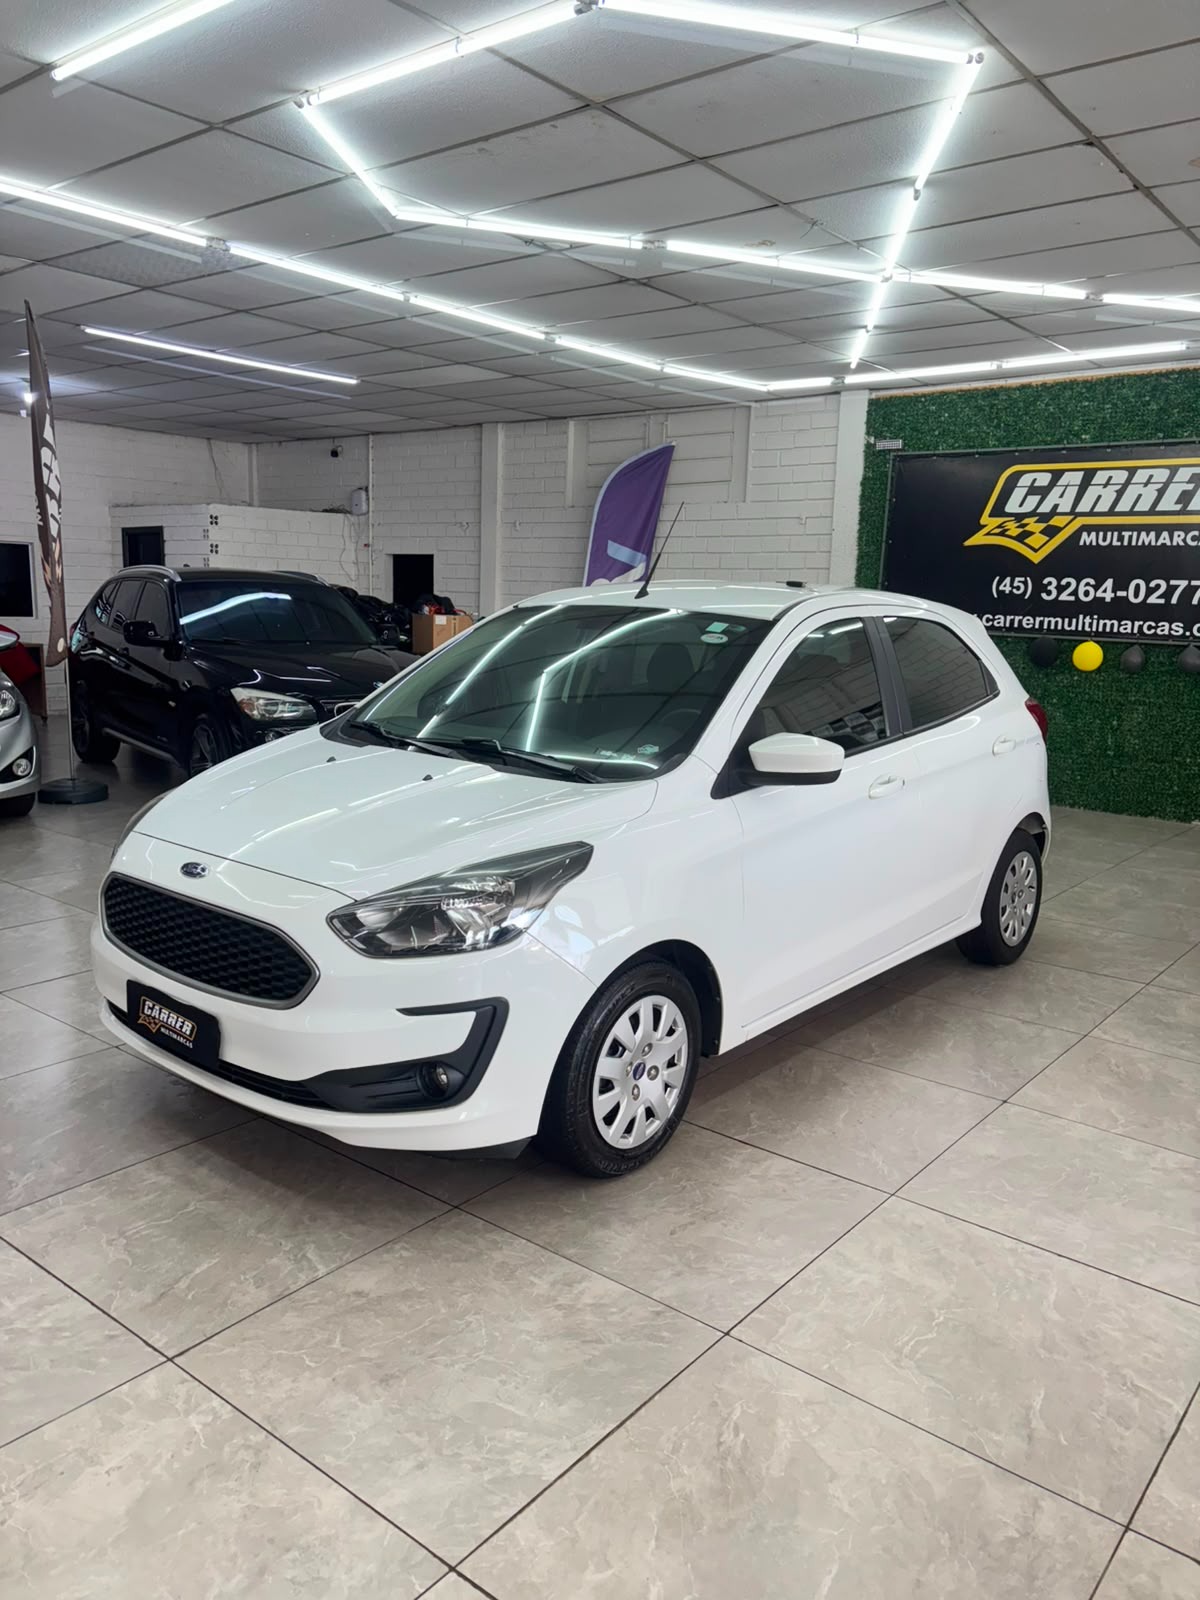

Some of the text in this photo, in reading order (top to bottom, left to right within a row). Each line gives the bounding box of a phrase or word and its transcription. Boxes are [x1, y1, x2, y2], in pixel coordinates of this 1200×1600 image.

[1004, 467, 1200, 513] CARRE
[1079, 531, 1200, 546] MULTIMARC
[992, 576, 1033, 599] (45)
[143, 1000, 193, 1035] CARRER
